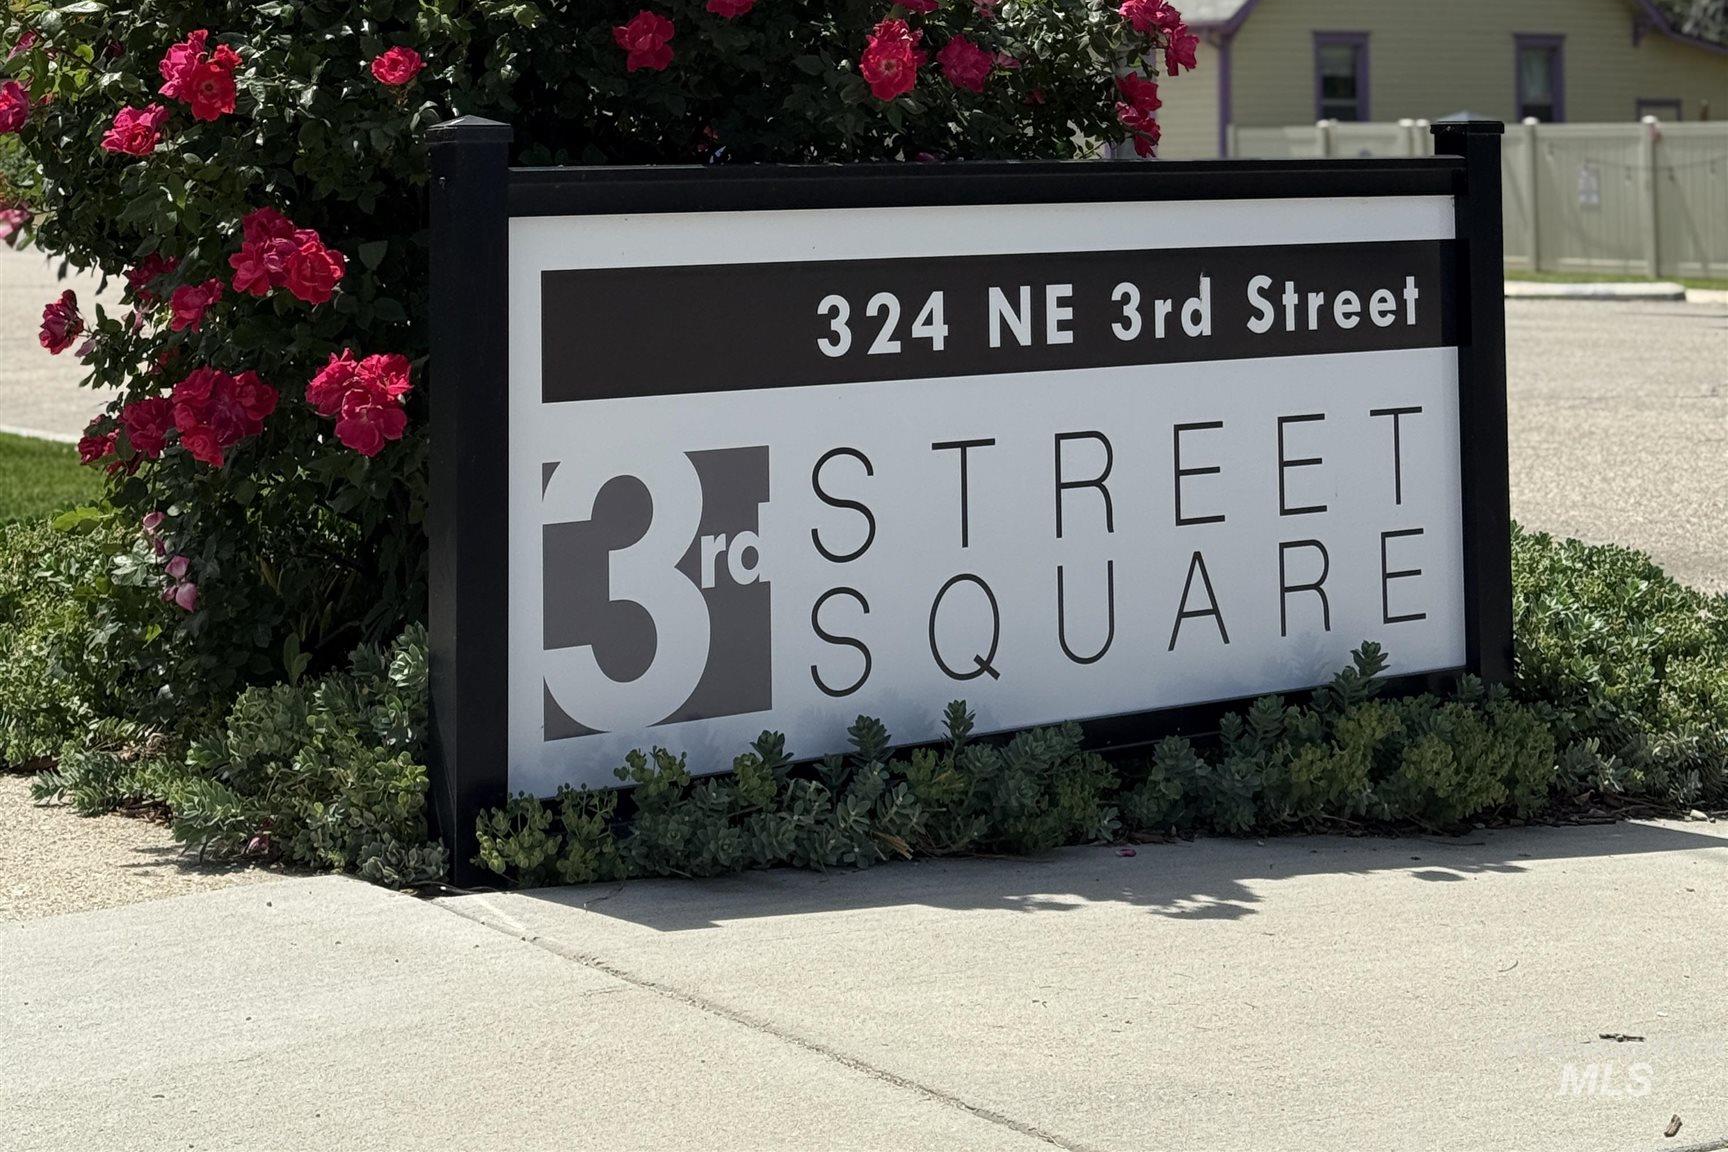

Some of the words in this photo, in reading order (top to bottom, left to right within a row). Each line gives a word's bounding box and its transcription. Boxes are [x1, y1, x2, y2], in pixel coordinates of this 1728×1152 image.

[816, 291, 949, 357] 324
[988, 284, 1074, 347] NE
[1111, 276, 1213, 342] 3rd
[1246, 275, 1419, 334] Street
[811, 405, 1423, 563] STREET
[811, 528, 1426, 697] SQUARE
